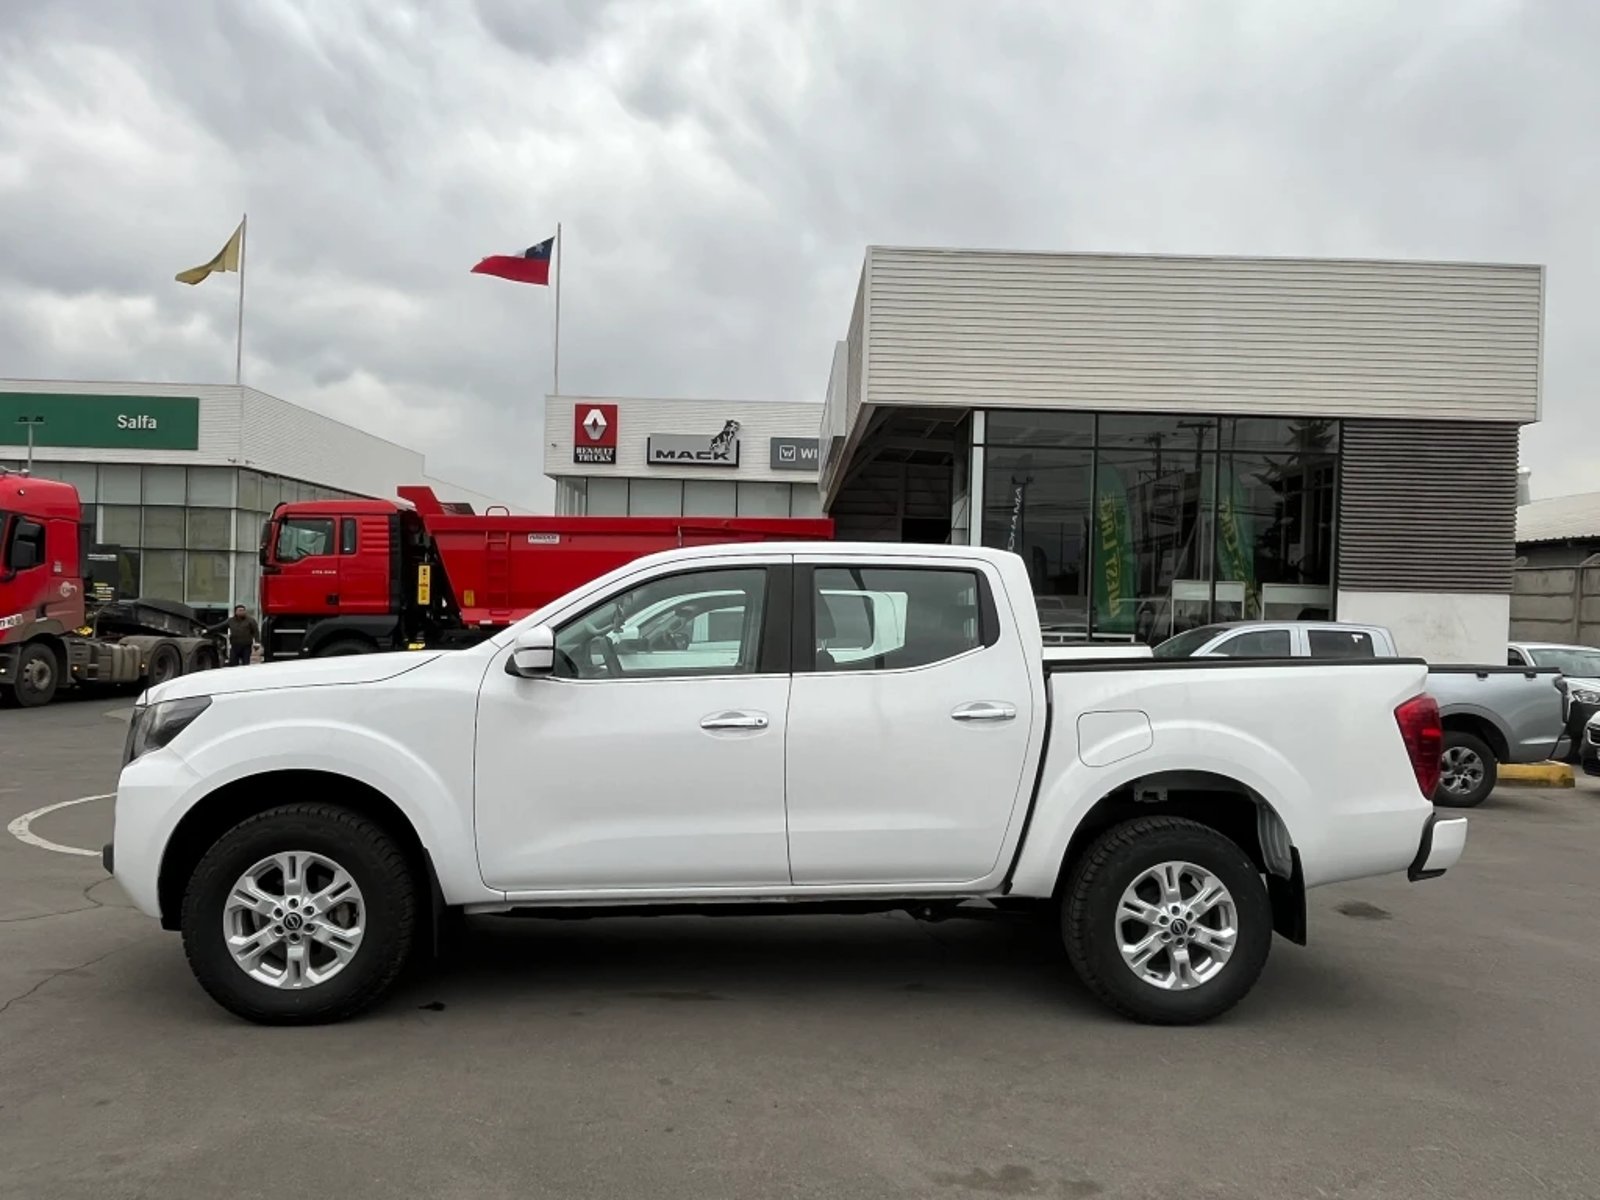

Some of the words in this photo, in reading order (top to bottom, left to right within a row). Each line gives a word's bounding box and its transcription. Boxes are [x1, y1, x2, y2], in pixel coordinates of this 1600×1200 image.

[117, 414, 157, 429] Salfa
[655, 450, 730, 461] MACK
[800, 448, 818, 459] WI
